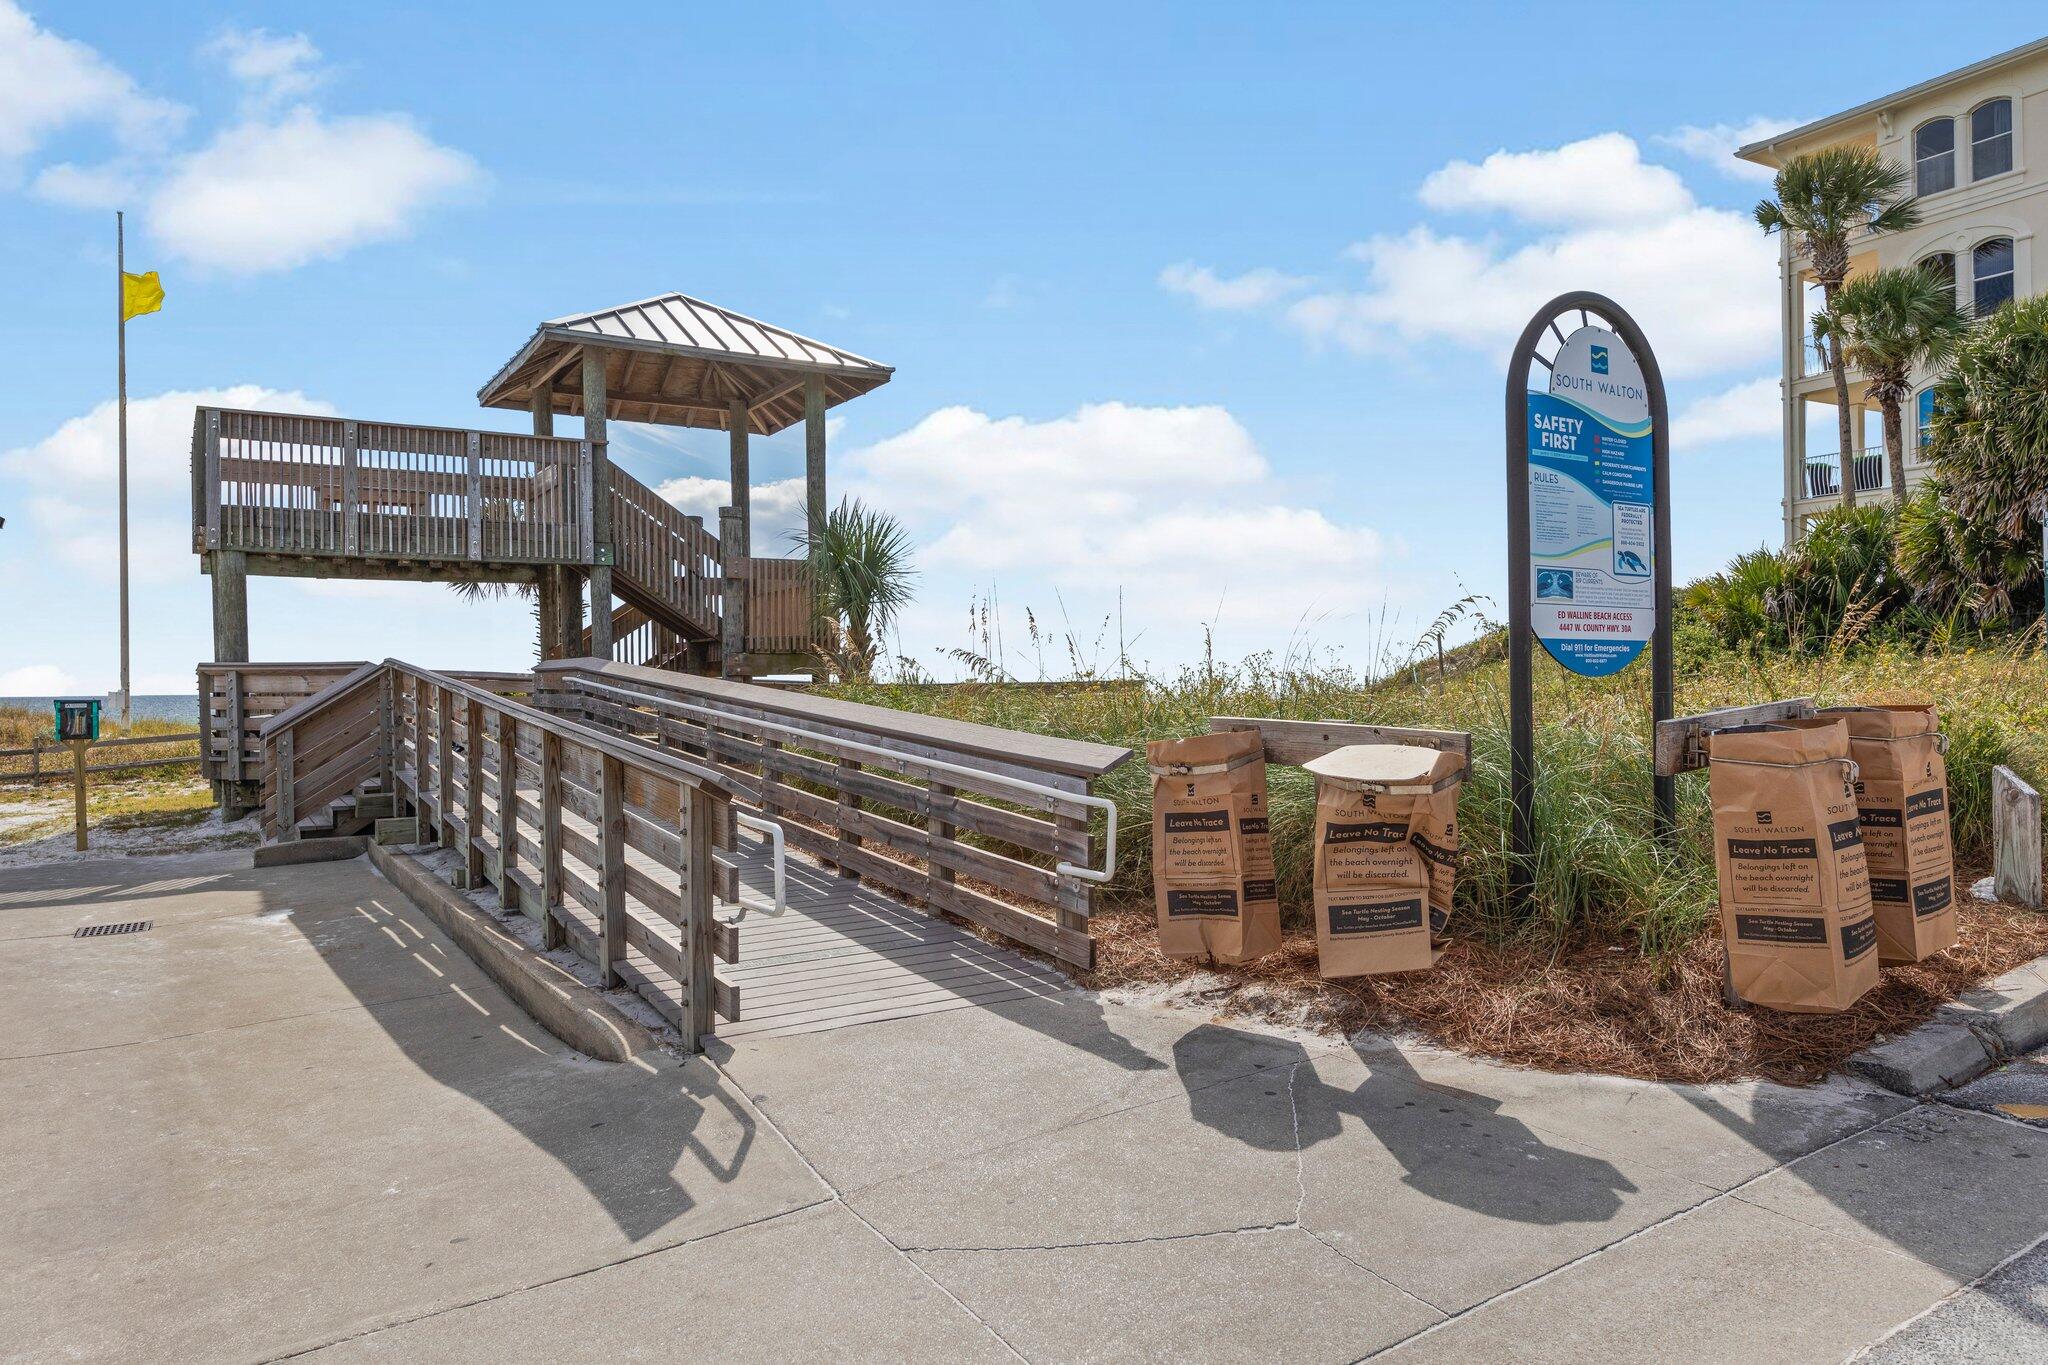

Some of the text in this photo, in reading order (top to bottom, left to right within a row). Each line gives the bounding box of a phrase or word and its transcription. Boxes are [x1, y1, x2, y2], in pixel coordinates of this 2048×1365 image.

[1555, 373, 1643, 401] SOUTH WALTON
[1534, 412, 1584, 435] SAFETY
[1541, 431, 1577, 451] FIRST
[1534, 471, 1559, 484] RULES
[1557, 611, 1633, 621] ED WALLINE BEACH ACCESS
[1559, 624, 1573, 632] 4447
[1582, 624, 1606, 632] COUNTY
[1621, 625, 1632, 633] 30A
[1561, 643, 1630, 653] Dial 911 for Emergencies
[1918, 799, 1926, 808] No
[1335, 808, 1365, 818] SOUTH
[1869, 813, 1897, 823] Trace
[1169, 818, 1224, 828] Leave No Trace
[1329, 829, 1361, 839] Leave
[1363, 828, 1379, 837] No
[1734, 826, 1805, 834] SOUTH WALTON
[1869, 829, 1882, 838] left
[1833, 831, 1854, 843] Leave
[1169, 848, 1181, 856] the
[1332, 846, 1379, 856] Belongings
[1380, 846, 1395, 856] left
[1412, 835, 1445, 860] Leave No
[1733, 845, 1811, 855] Leave No Trace
[1187, 859, 1197, 867] be
[1344, 858, 1371, 866] beach
[1372, 857, 1414, 868] overnight
[1737, 862, 1781, 872] Belongings
[1782, 862, 1796, 872] left
[1336, 869, 1410, 879] will be discarded.
[1735, 874, 1814, 883] the beach overnight
[1839, 870, 1849, 880] the
[1769, 884, 1810, 893] discarded.
[1845, 882, 1856, 893] will
[1856, 881, 1862, 890] be
